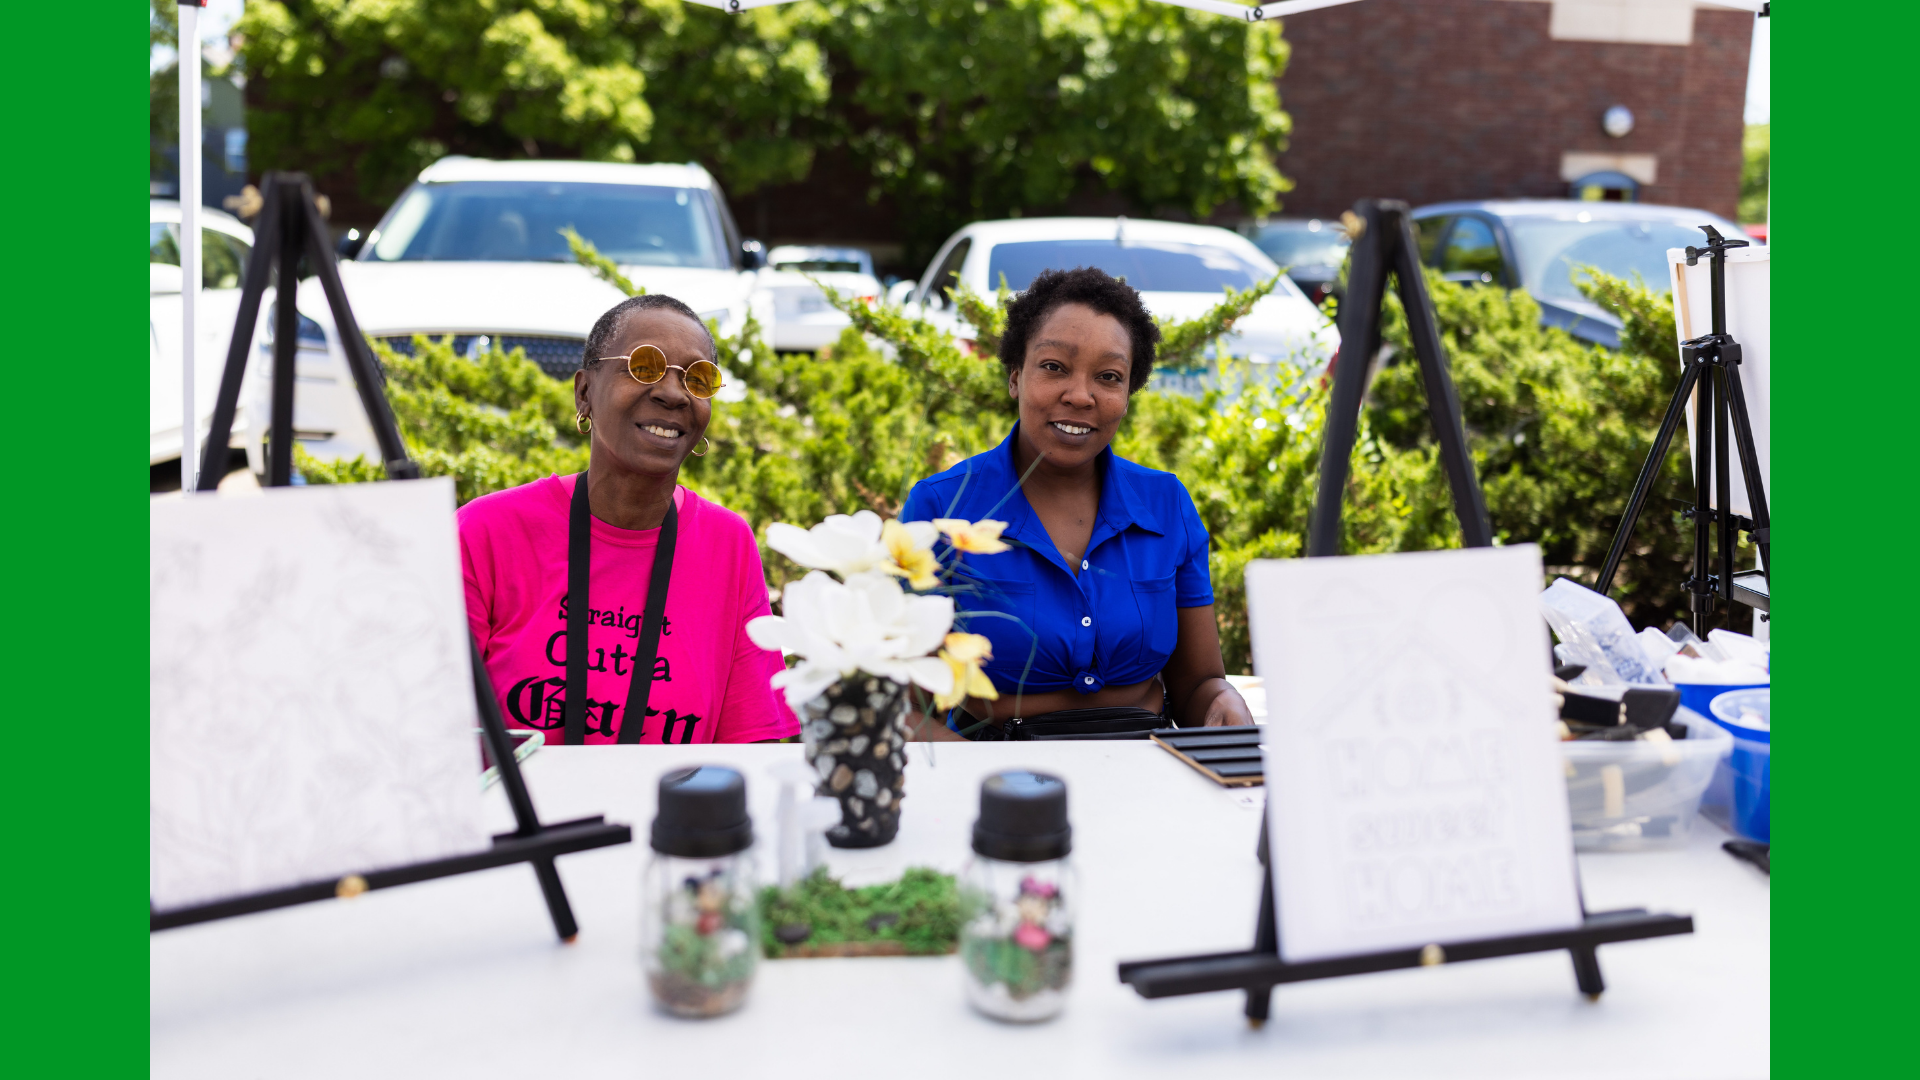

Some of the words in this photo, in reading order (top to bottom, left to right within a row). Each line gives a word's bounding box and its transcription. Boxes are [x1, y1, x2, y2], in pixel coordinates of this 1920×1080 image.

[546, 631, 671, 681] Outa
[1325, 729, 1507, 800] HOME
[1344, 849, 1521, 920] HOME
